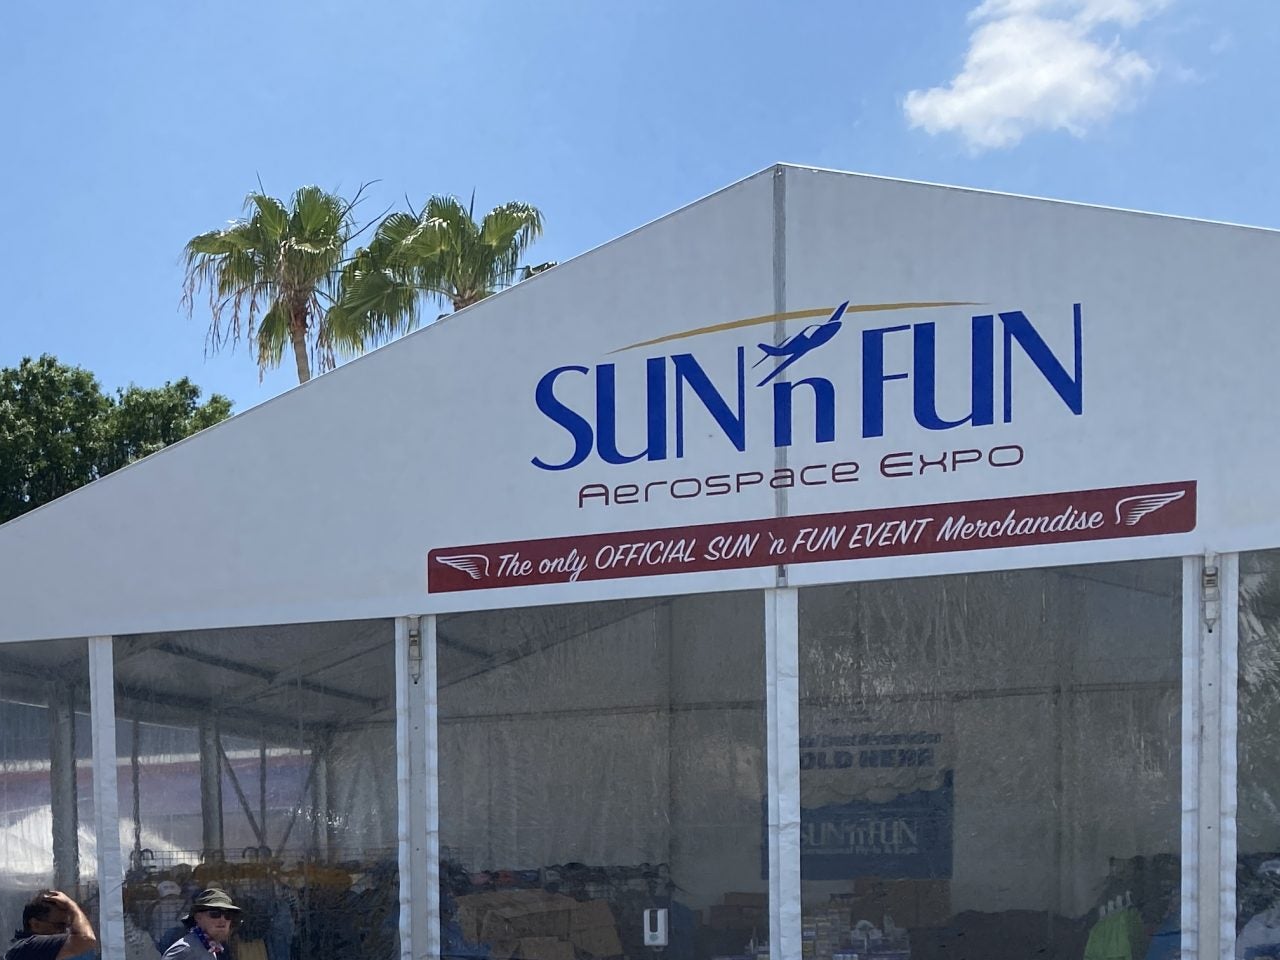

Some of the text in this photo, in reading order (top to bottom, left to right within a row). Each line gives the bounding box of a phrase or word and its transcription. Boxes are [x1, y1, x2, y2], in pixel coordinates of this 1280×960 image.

[530, 345, 746, 471] SUN
[861, 303, 1083, 438] FUN
[497, 551, 533, 577] The
[538, 548, 588, 582] only
[594, 537, 697, 570] OFFICIAL
[704, 532, 760, 562] SUN
[791, 525, 848, 554] FUN
[848, 517, 935, 550] EVENT
[936, 504, 1105, 543] Merchandise
